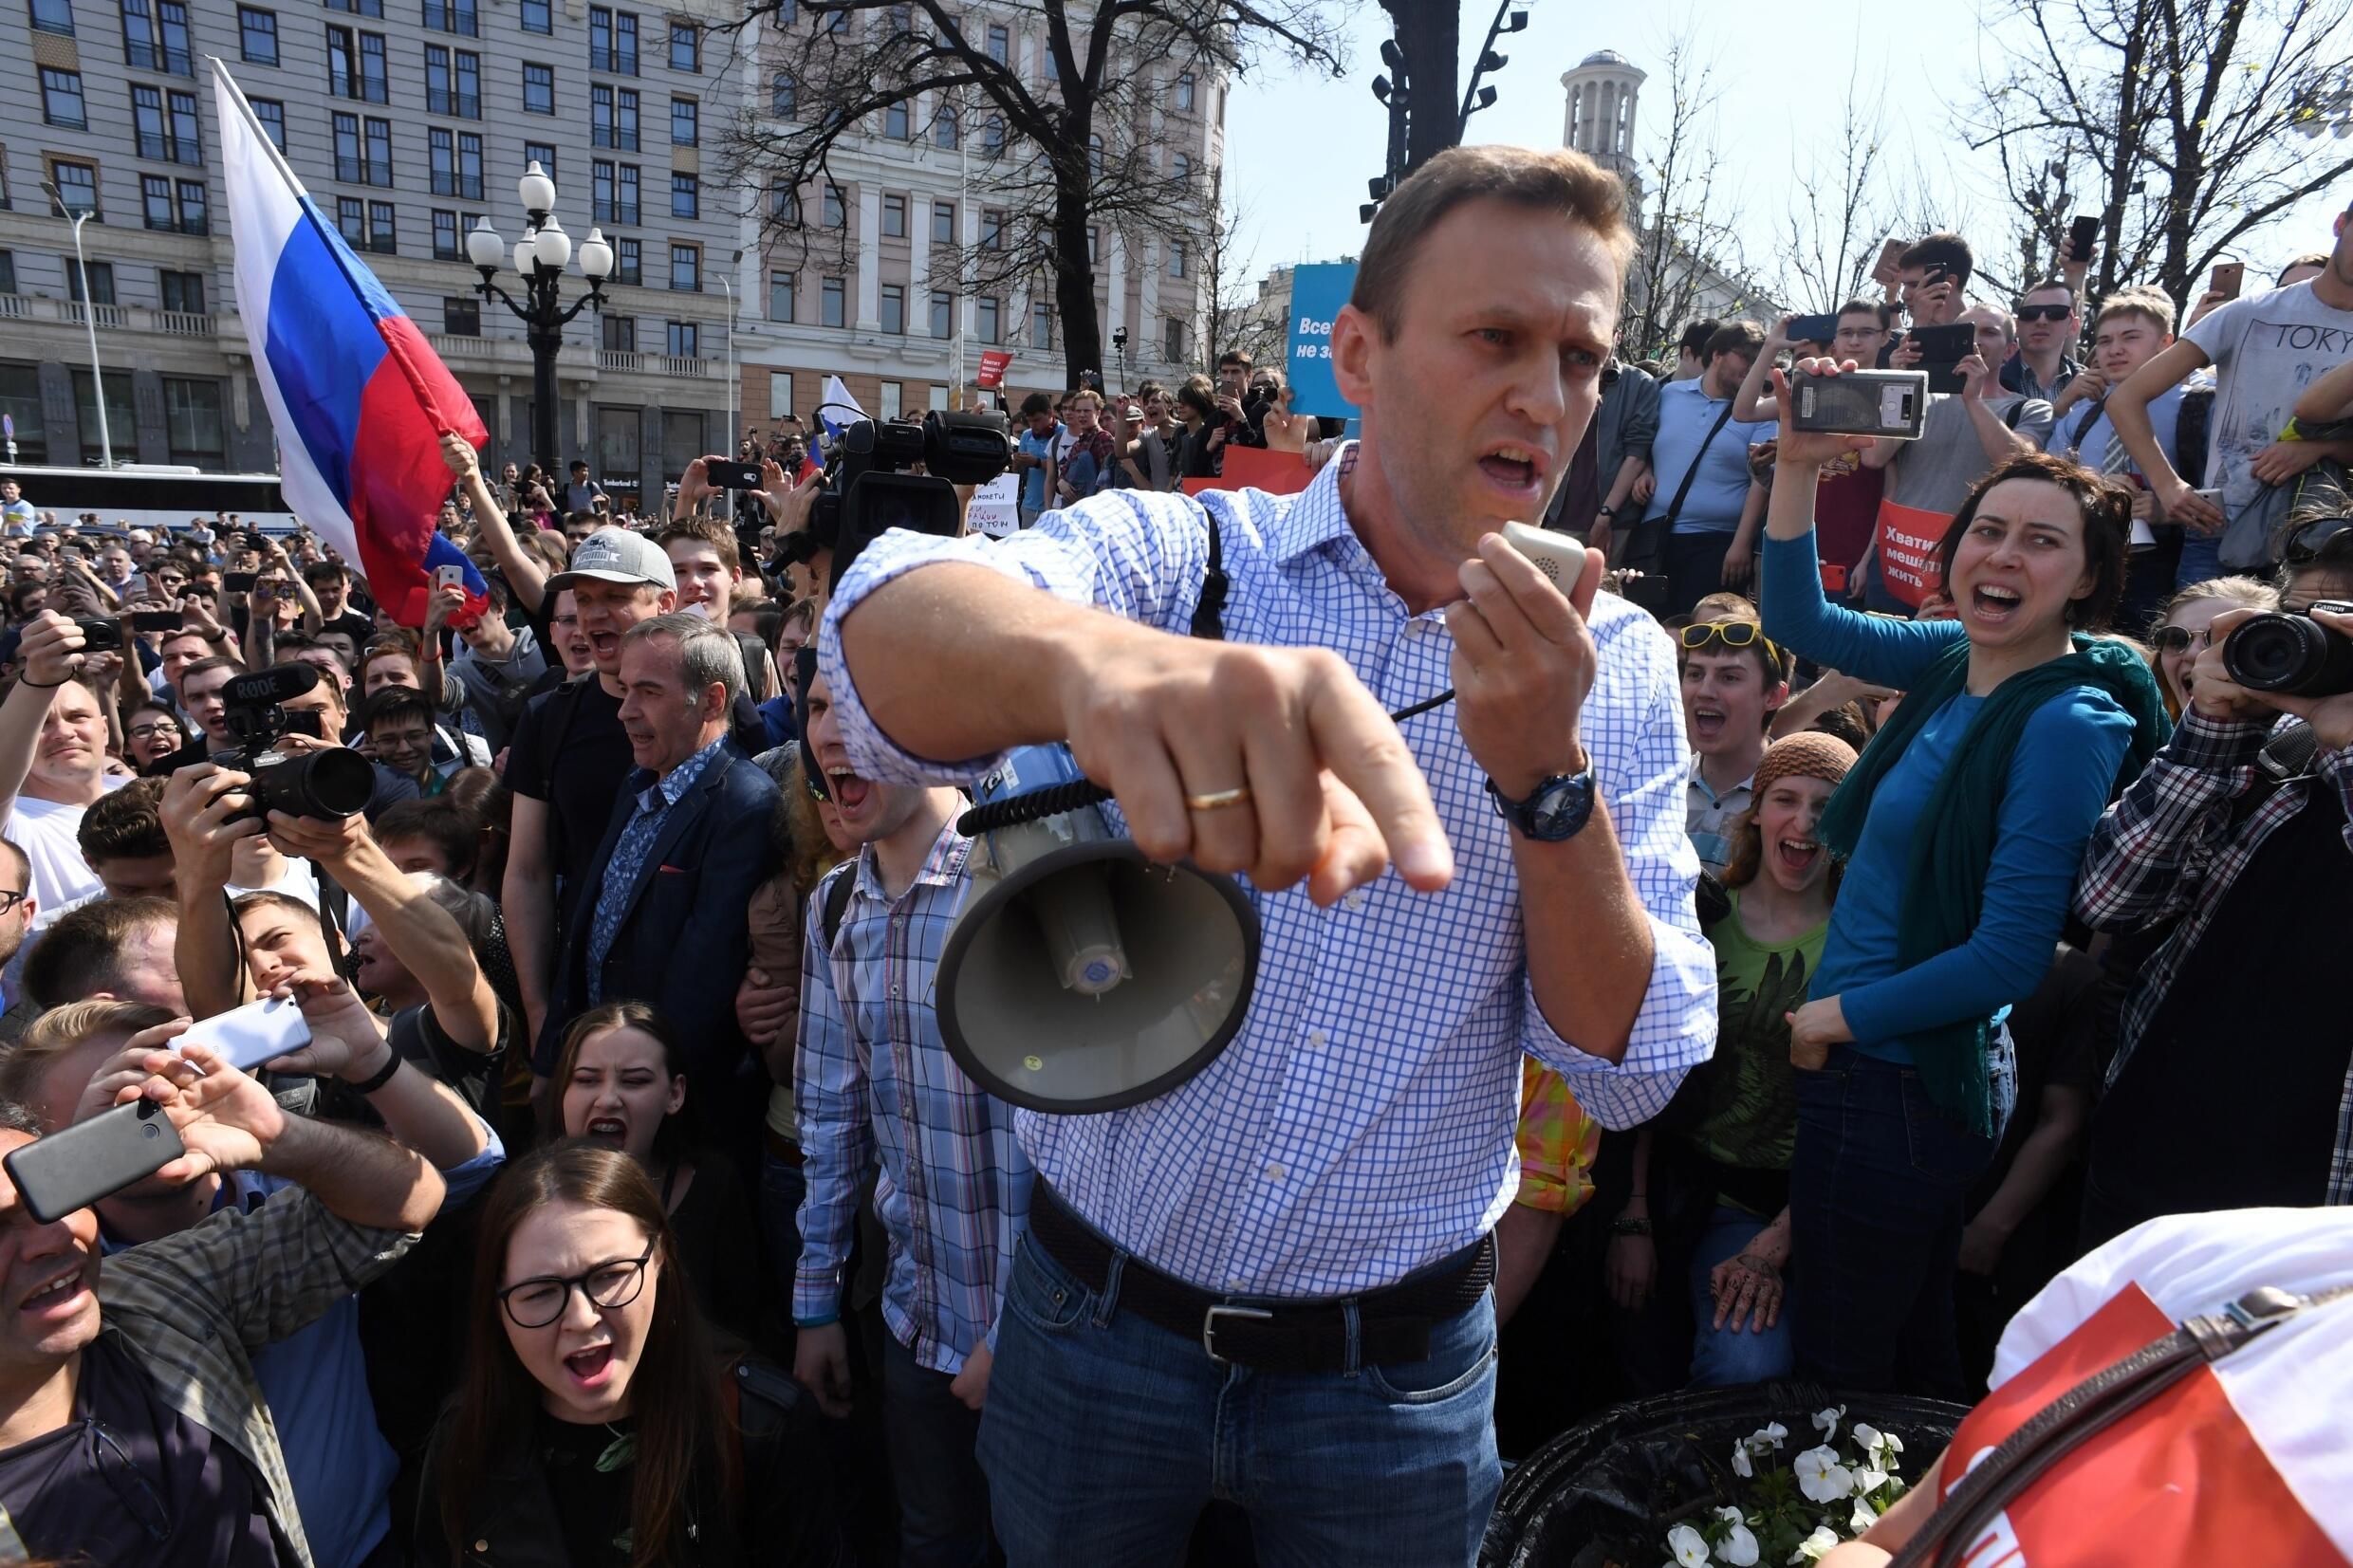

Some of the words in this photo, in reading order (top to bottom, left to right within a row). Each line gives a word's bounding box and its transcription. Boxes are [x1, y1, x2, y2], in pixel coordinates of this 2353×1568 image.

[2277, 324, 2353, 354] TOKY
[1296, 344, 1317, 358] не
[603, 478, 631, 487] Timberland
[1885, 526, 1936, 552] Хвати
[1887, 565, 1923, 588] жить
[2314, 602, 2344, 612] Canon
